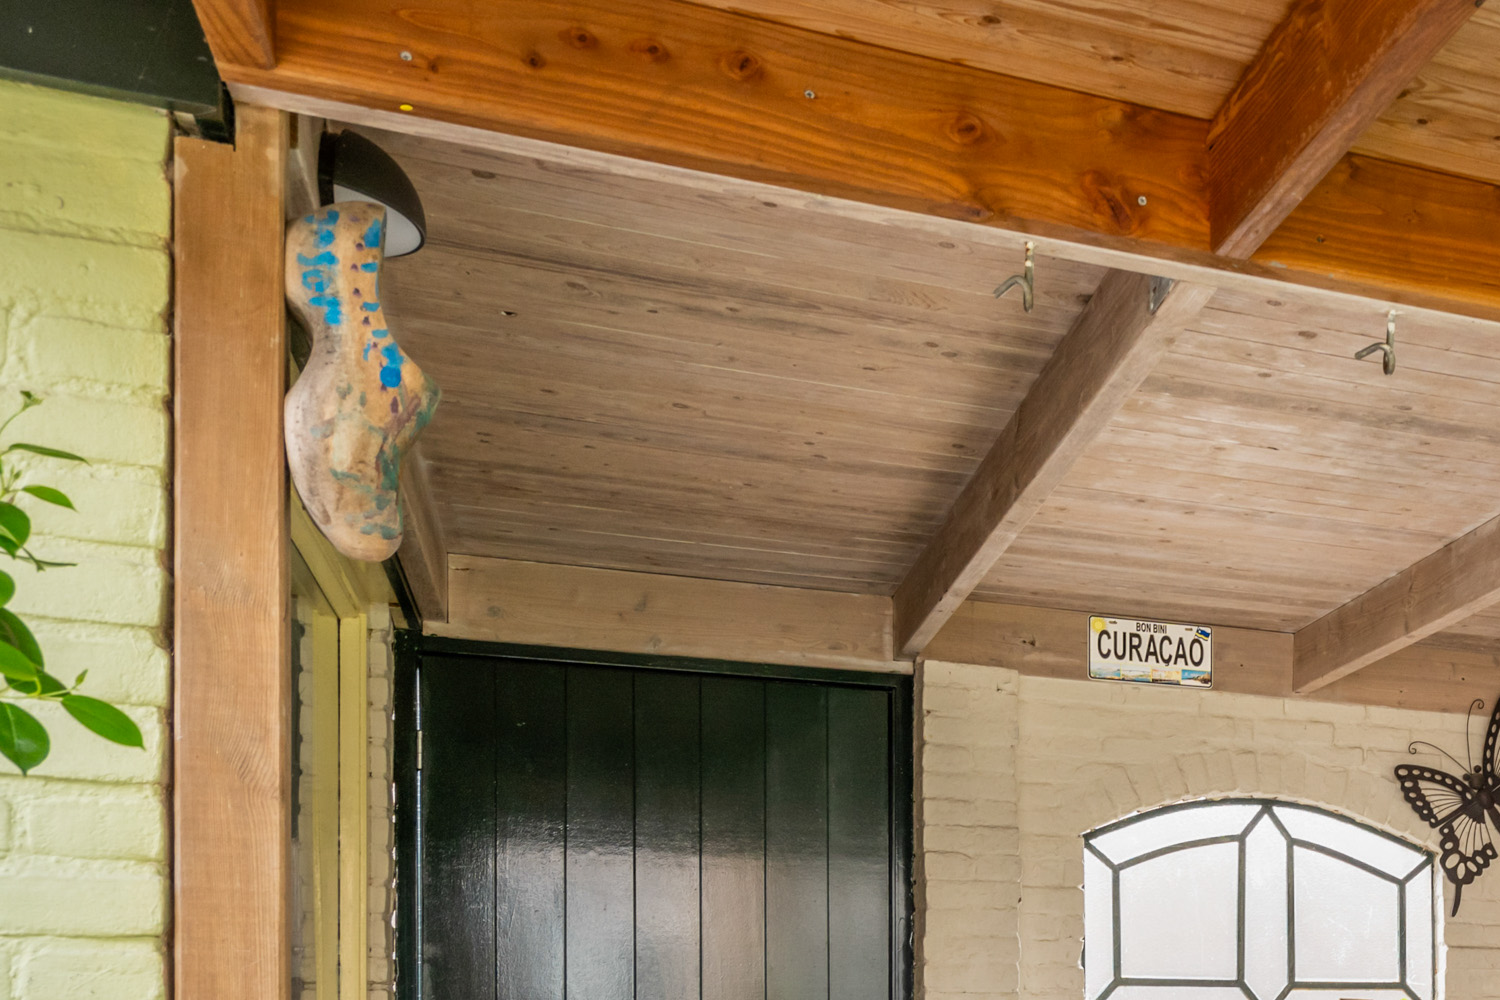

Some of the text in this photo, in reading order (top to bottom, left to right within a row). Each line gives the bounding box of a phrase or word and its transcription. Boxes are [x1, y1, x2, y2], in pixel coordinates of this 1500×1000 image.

[1135, 622, 1168, 634] BON BINI
[1097, 629, 1204, 667] CURAÇAO
